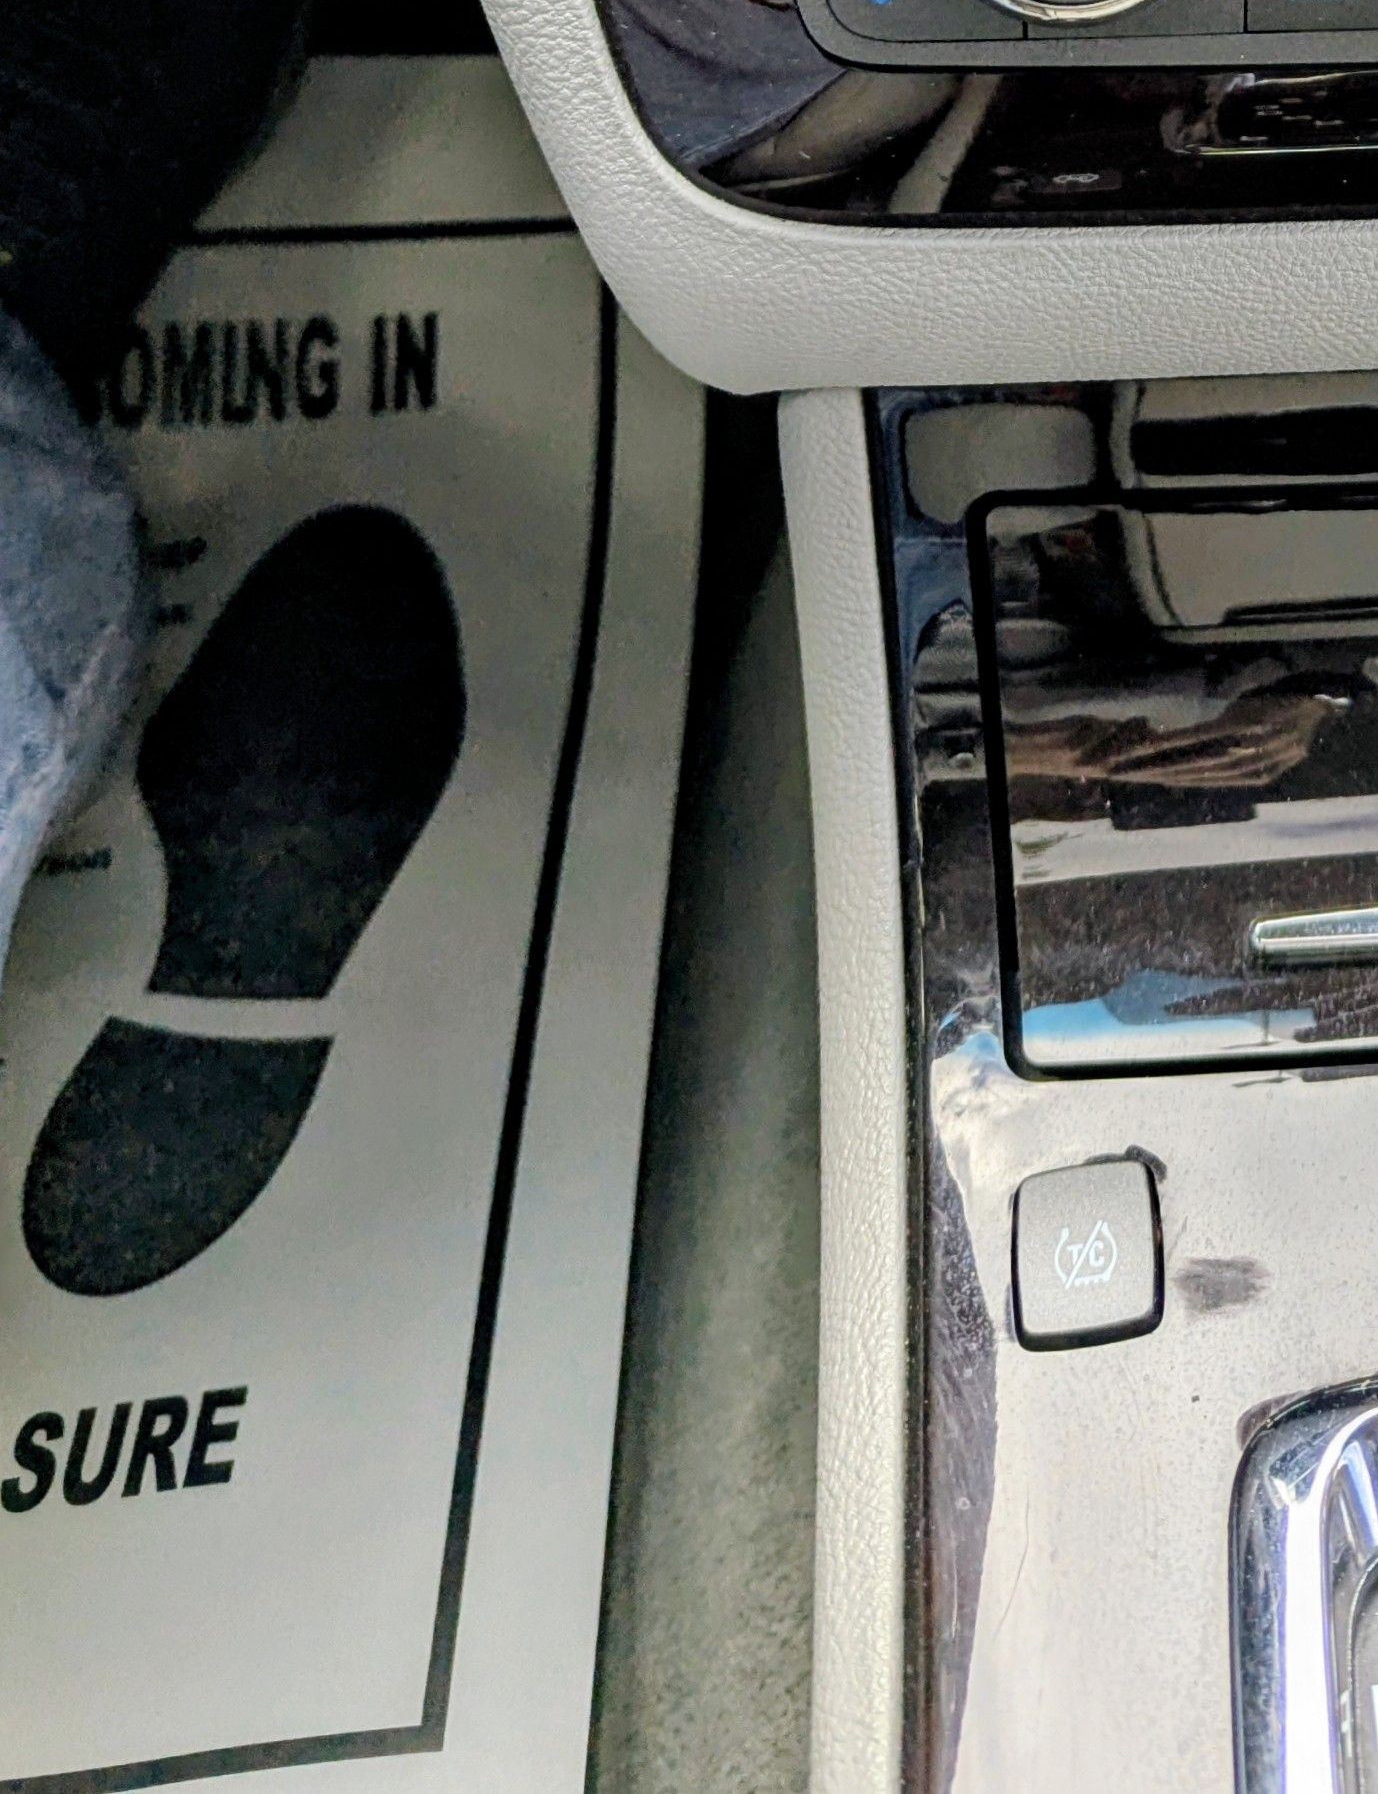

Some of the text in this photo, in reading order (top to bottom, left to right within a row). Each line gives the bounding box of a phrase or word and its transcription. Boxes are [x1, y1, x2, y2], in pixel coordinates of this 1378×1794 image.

[76, 310, 440, 424] OMING IN
[0, 1385, 248, 1513] SURE
